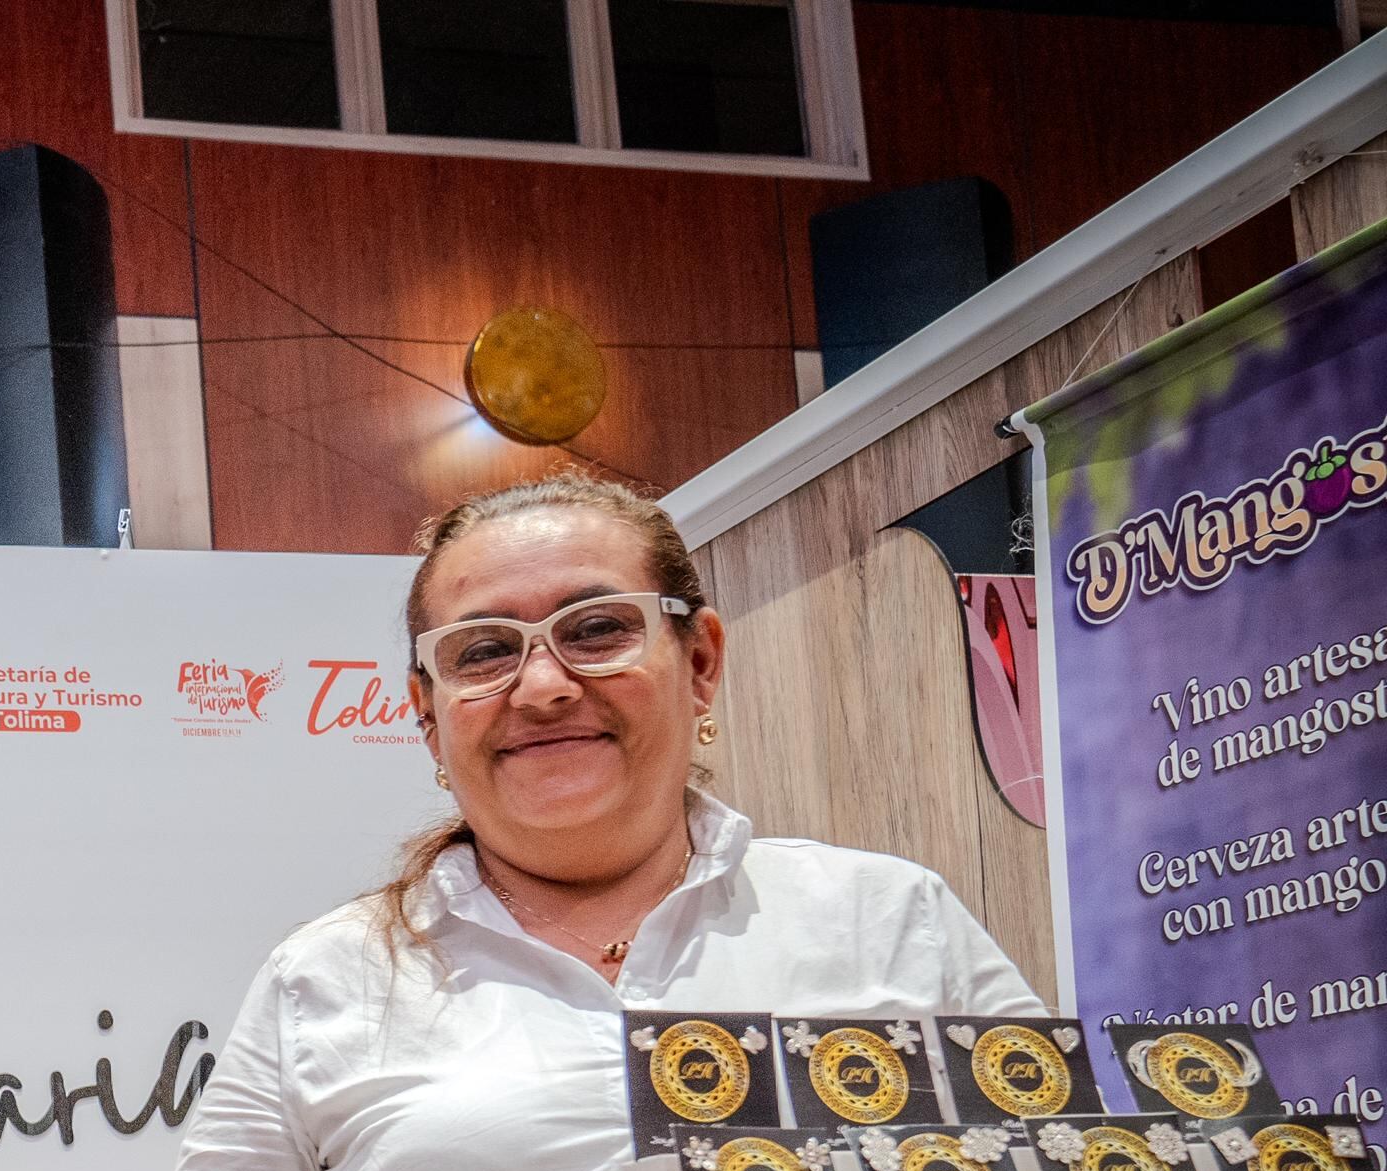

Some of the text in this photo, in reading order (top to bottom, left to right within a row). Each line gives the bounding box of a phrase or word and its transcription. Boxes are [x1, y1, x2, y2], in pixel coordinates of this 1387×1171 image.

[34, 692, 47, 708] y
[54, 688, 142, 707] Turismo
[64, 667, 91, 684] de
[178, 658, 229, 693] Feria
[307, 660, 414, 735] Toli
[199, 694, 245, 715] Turismo
[1153, 676, 1252, 732] Vino
[182, 727, 221, 737] DICIEMBRE
[353, 734, 421, 745] CORAZÓN DE
[1157, 742, 1201, 788] de
[1138, 827, 1295, 895] Cerveza
[1162, 858, 1387, 943] con mango
[1251, 979, 1297, 1029] de
[1334, 1076, 1384, 1122] de
